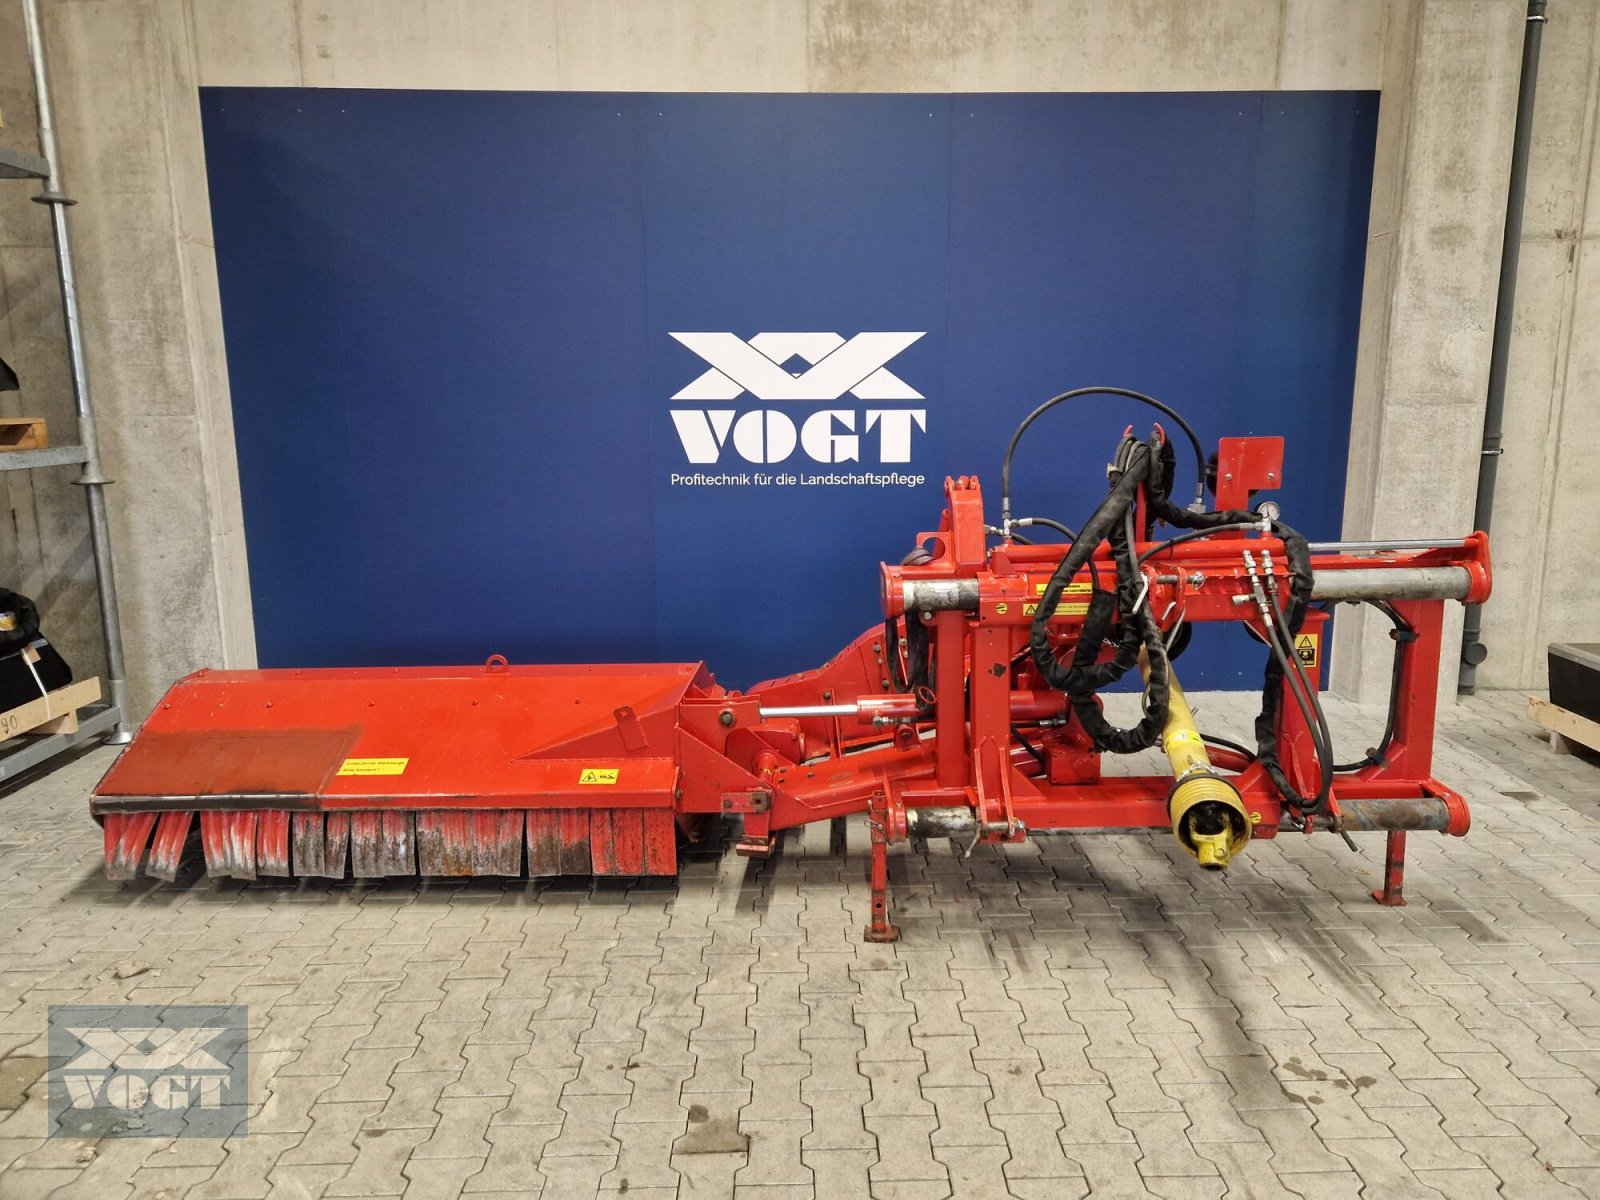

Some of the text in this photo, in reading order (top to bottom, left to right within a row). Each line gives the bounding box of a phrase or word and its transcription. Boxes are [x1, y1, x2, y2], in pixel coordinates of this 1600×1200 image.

[669, 409, 927, 464] VOGT
[671, 472, 926, 488] Profitechnik für die Landschaftspflege
